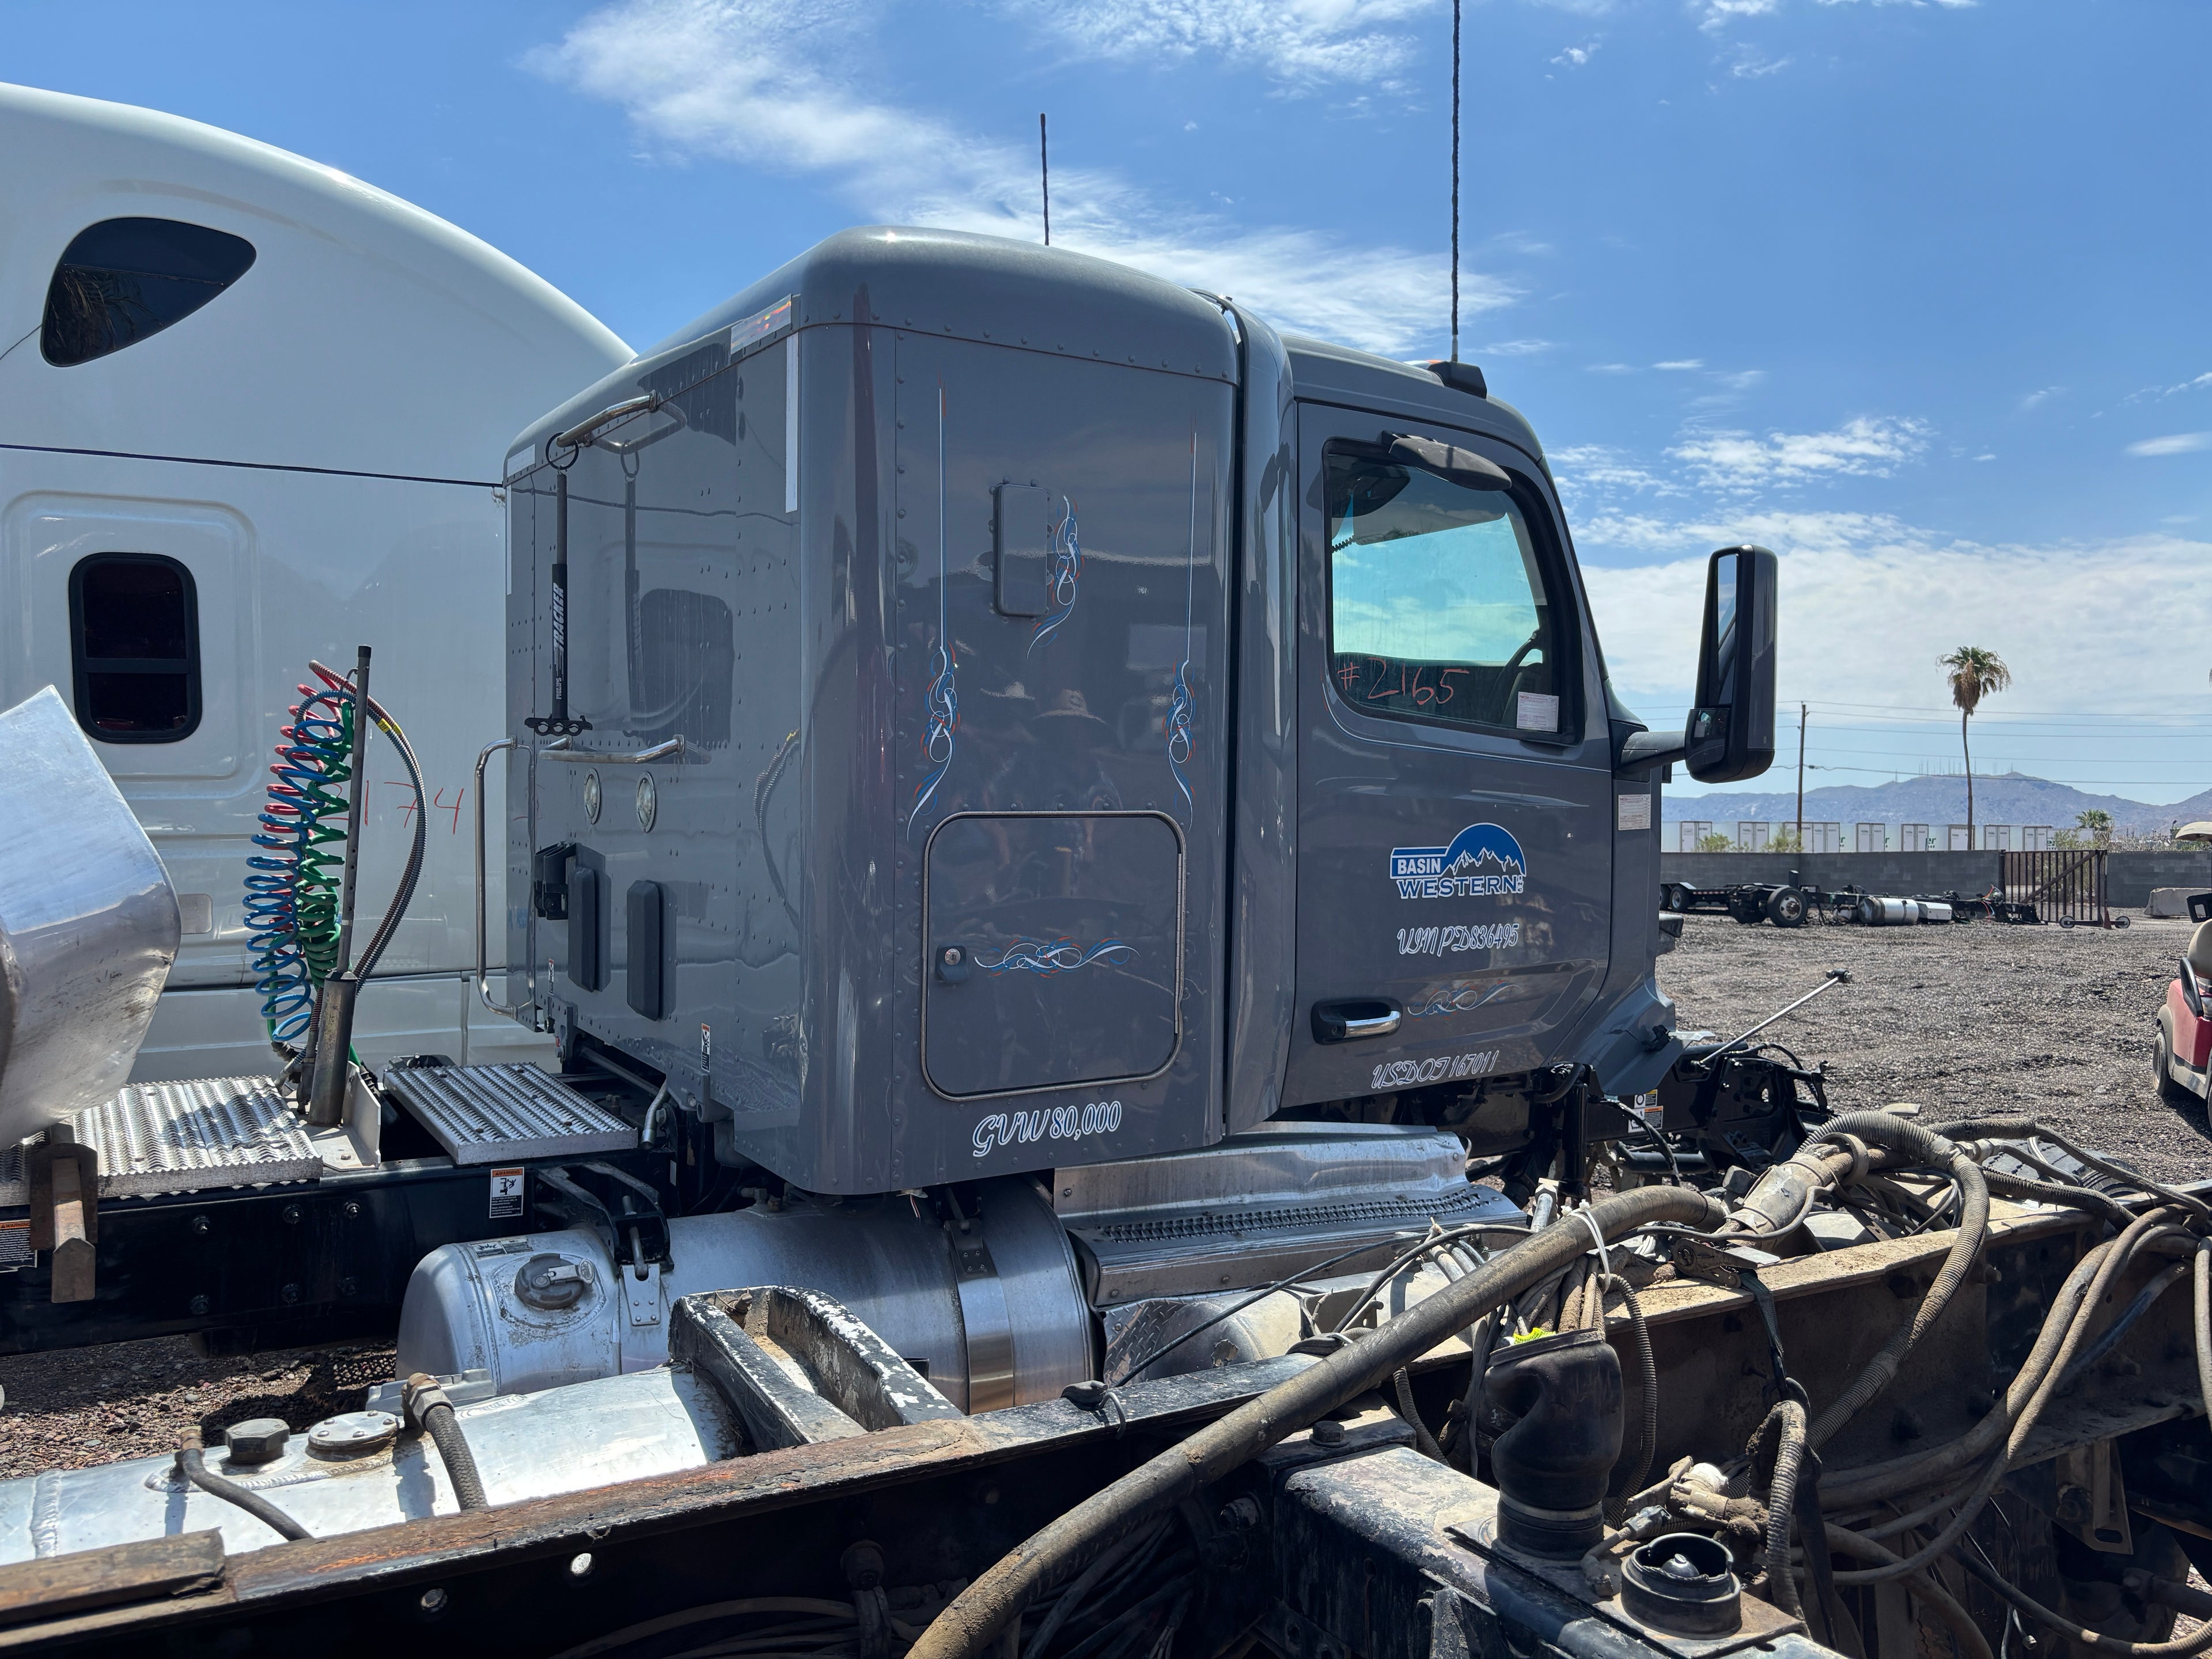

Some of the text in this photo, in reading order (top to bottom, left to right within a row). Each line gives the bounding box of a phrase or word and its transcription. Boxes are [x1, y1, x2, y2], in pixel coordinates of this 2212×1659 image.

[552, 582, 565, 652] TRACKER
[1338, 657, 1469, 705] #2165
[1397, 858, 1441, 875] BASIN
[1397, 875, 1517, 899] WESTERN
[1397, 923, 1520, 957] VIN PD836495
[1371, 1050, 1499, 1089] USDOT 167011
[972, 1100, 1122, 1157] GVW 80,000
